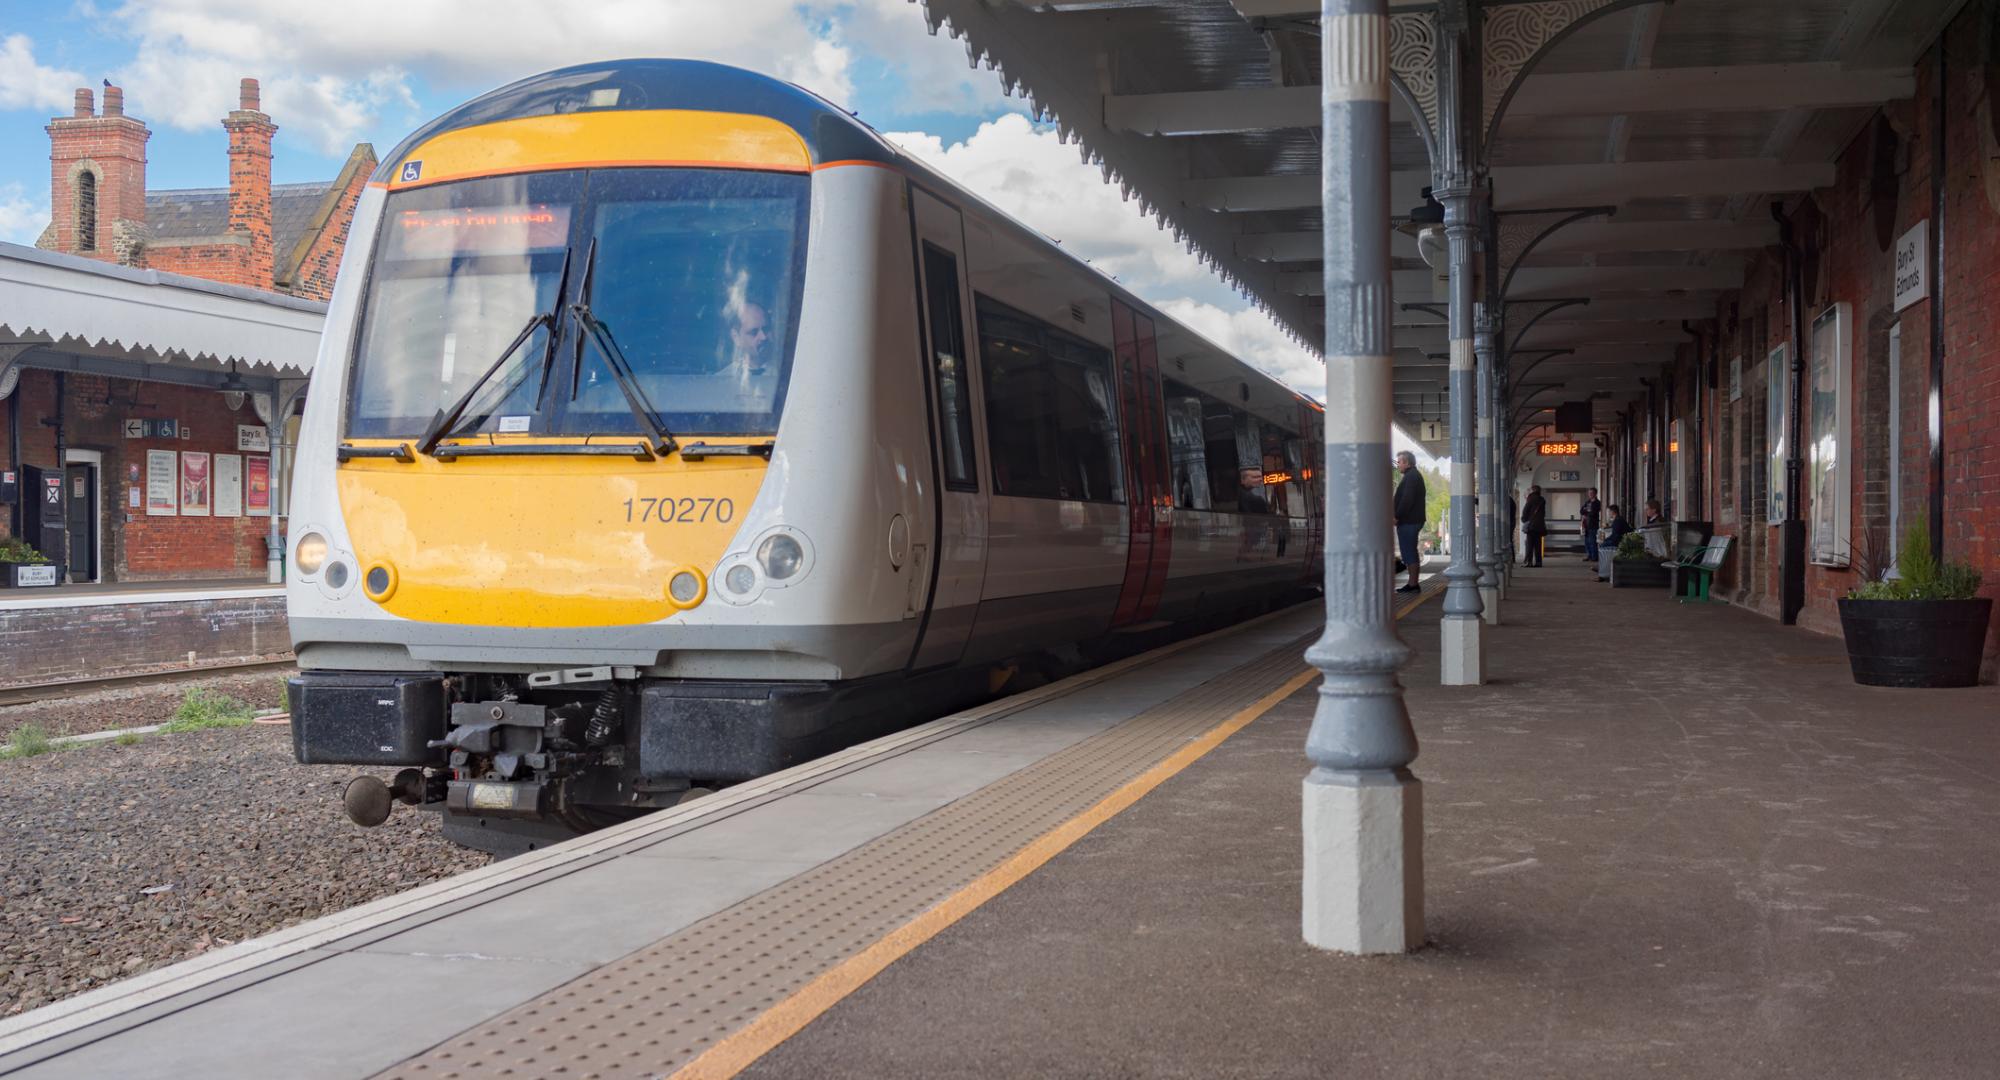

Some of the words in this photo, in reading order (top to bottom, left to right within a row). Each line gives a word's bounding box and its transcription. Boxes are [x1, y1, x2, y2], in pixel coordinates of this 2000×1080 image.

[1898, 250, 1908, 271] Bury
[1909, 241, 1915, 263] St
[1896, 266, 1919, 297] Edmunds
[1428, 424, 1434, 439] 1
[1541, 444, 1578, 454] 16:36:32
[623, 497, 734, 523] 170270
